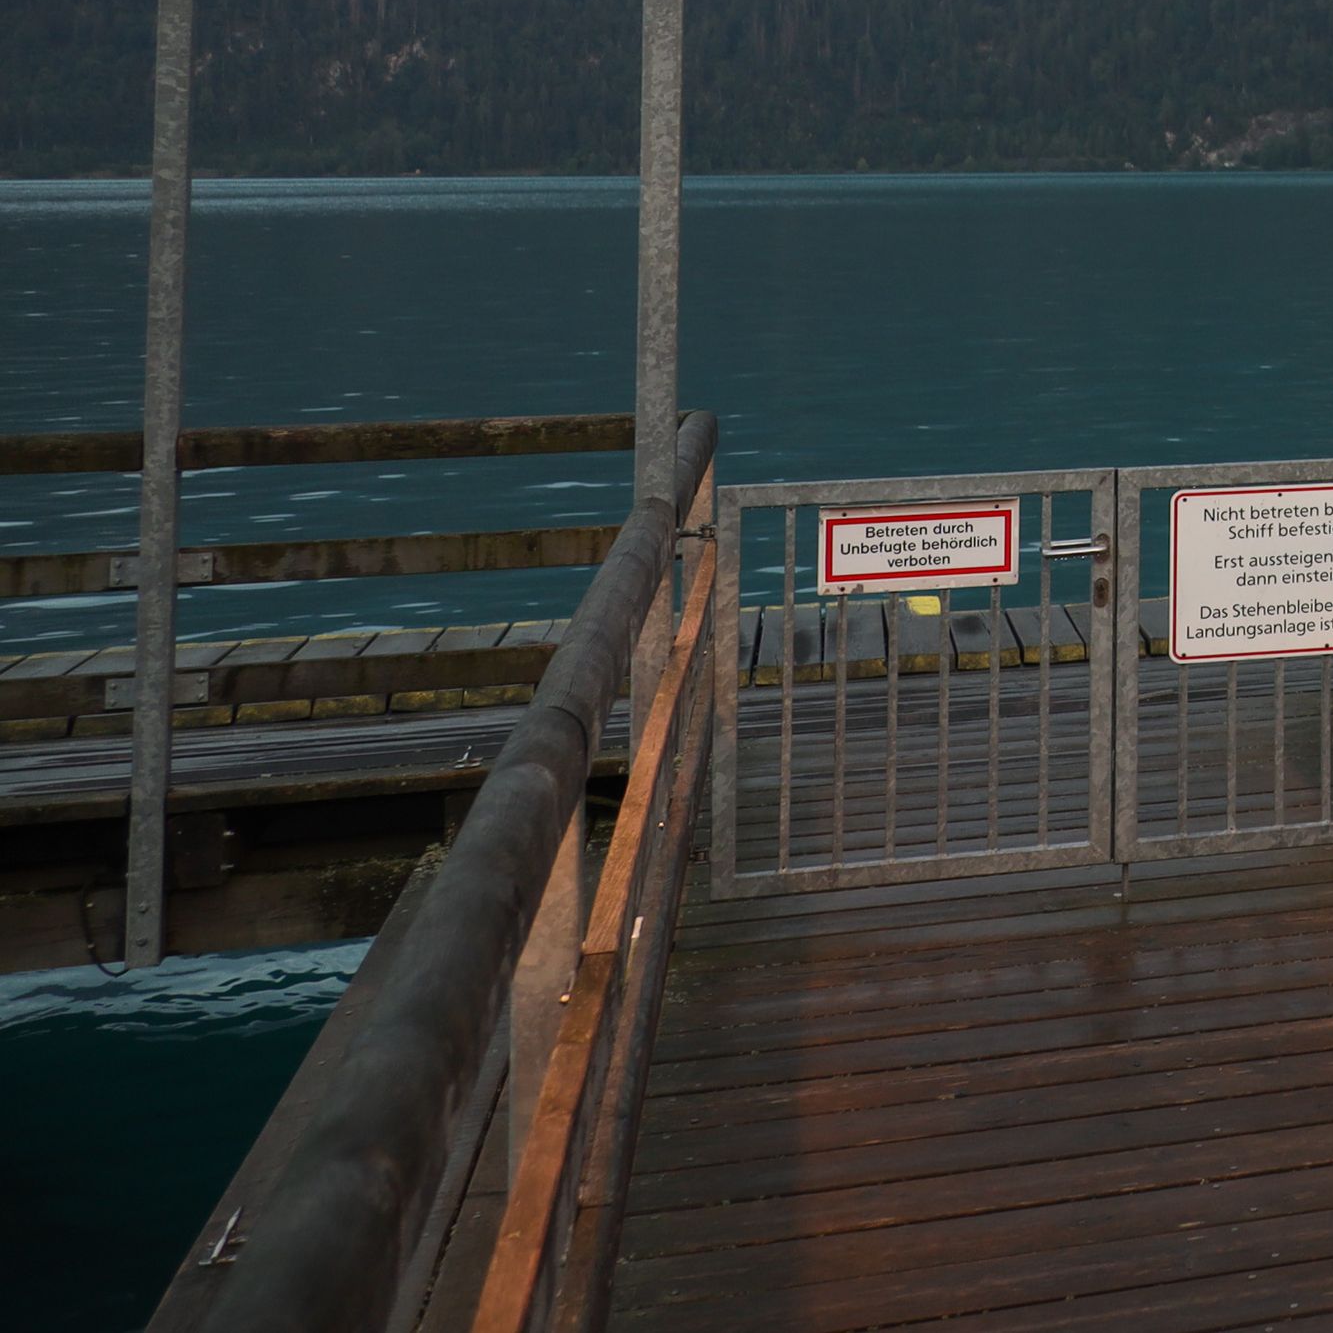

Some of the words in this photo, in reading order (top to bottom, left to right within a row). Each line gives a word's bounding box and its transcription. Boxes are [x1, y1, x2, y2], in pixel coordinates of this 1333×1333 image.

[1204, 506, 1245, 522] Nicht
[1250, 505, 1319, 520] betreten
[865, 524, 928, 539] Betreten
[933, 521, 974, 535] durch
[1228, 522, 1275, 540] Schiff
[840, 539, 917, 556] Unbefugte
[922, 536, 998, 551] behördlich
[887, 555, 951, 568] verboten
[1214, 553, 1244, 569] Erst
[1248, 549, 1333, 569] aussteigen
[1236, 572, 1277, 587] dann
[1199, 605, 1229, 619] Das
[1186, 616, 1316, 640] Landungsanlage
